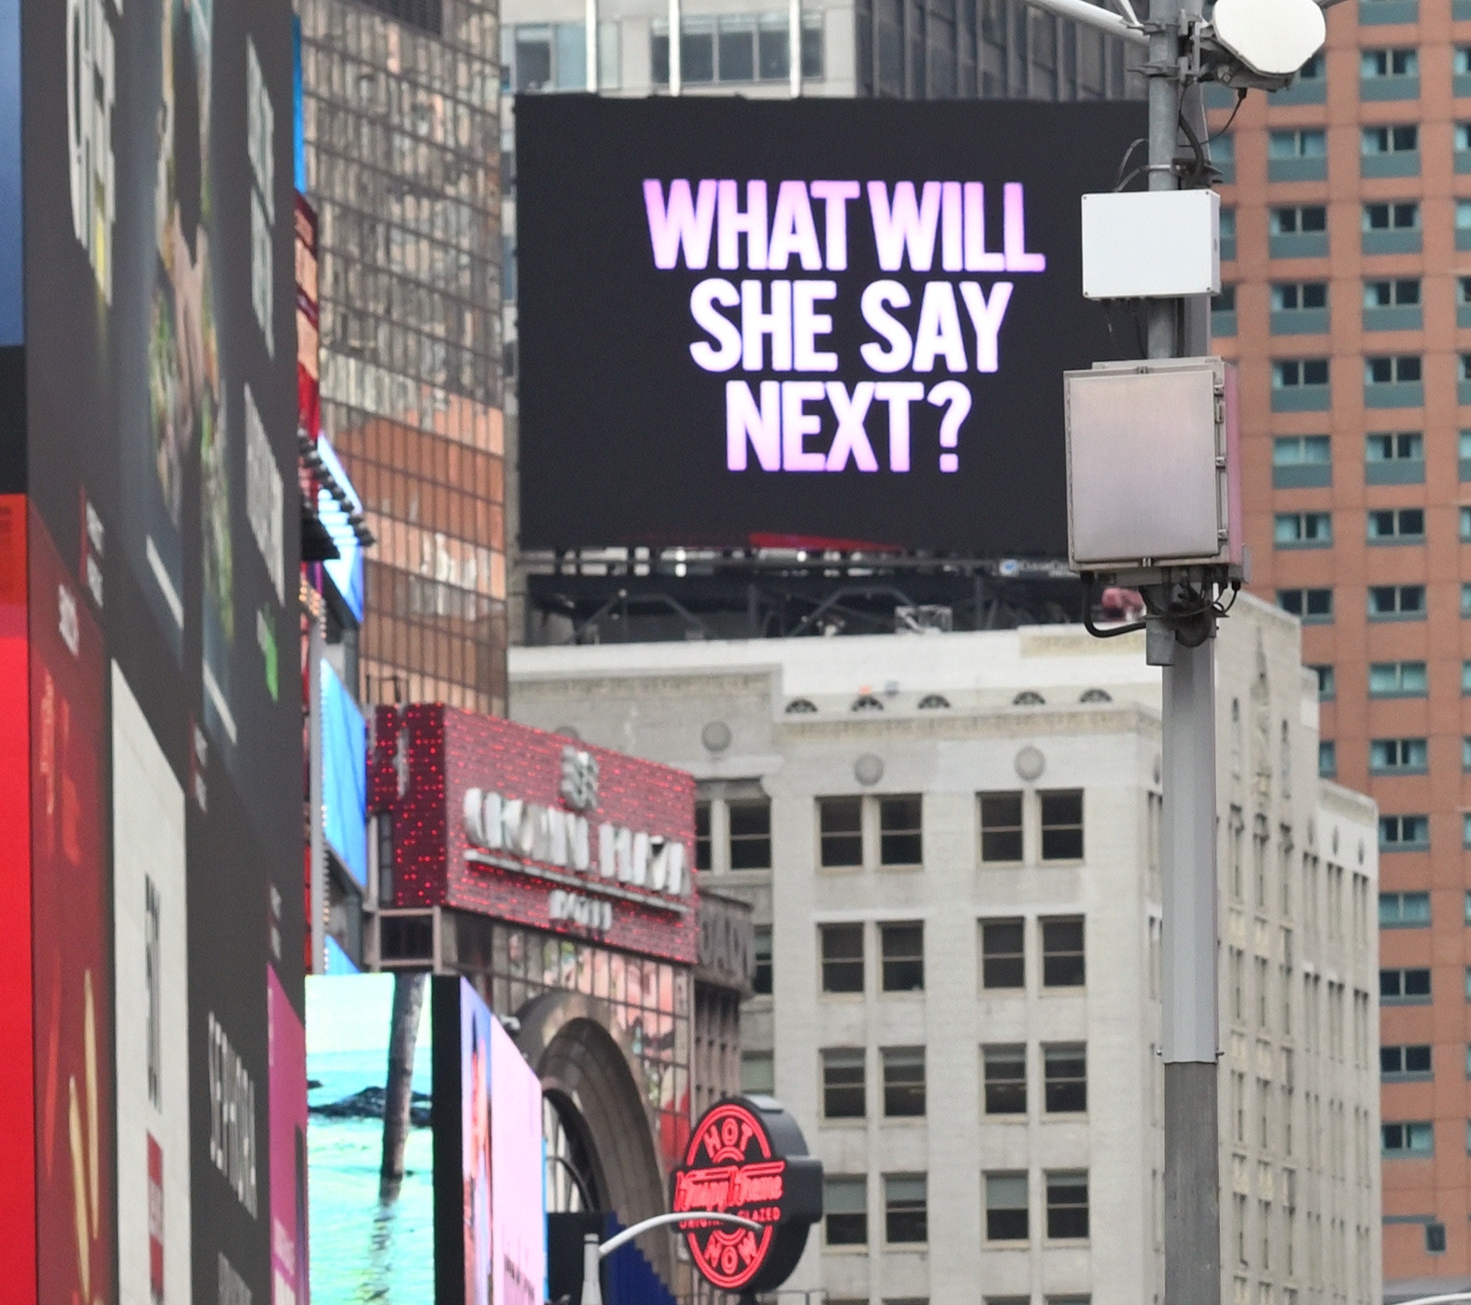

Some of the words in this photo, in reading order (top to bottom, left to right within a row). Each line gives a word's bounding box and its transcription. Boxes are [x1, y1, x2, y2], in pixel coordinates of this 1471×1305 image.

[643, 179, 860, 270] WHAT
[868, 180, 1046, 272] WILL
[689, 277, 837, 373] SHE
[860, 279, 1014, 373] SAY
[726, 381, 972, 473] NEXT?
[703, 1117, 753, 1163] HOT
[703, 1231, 759, 1269] NOW
